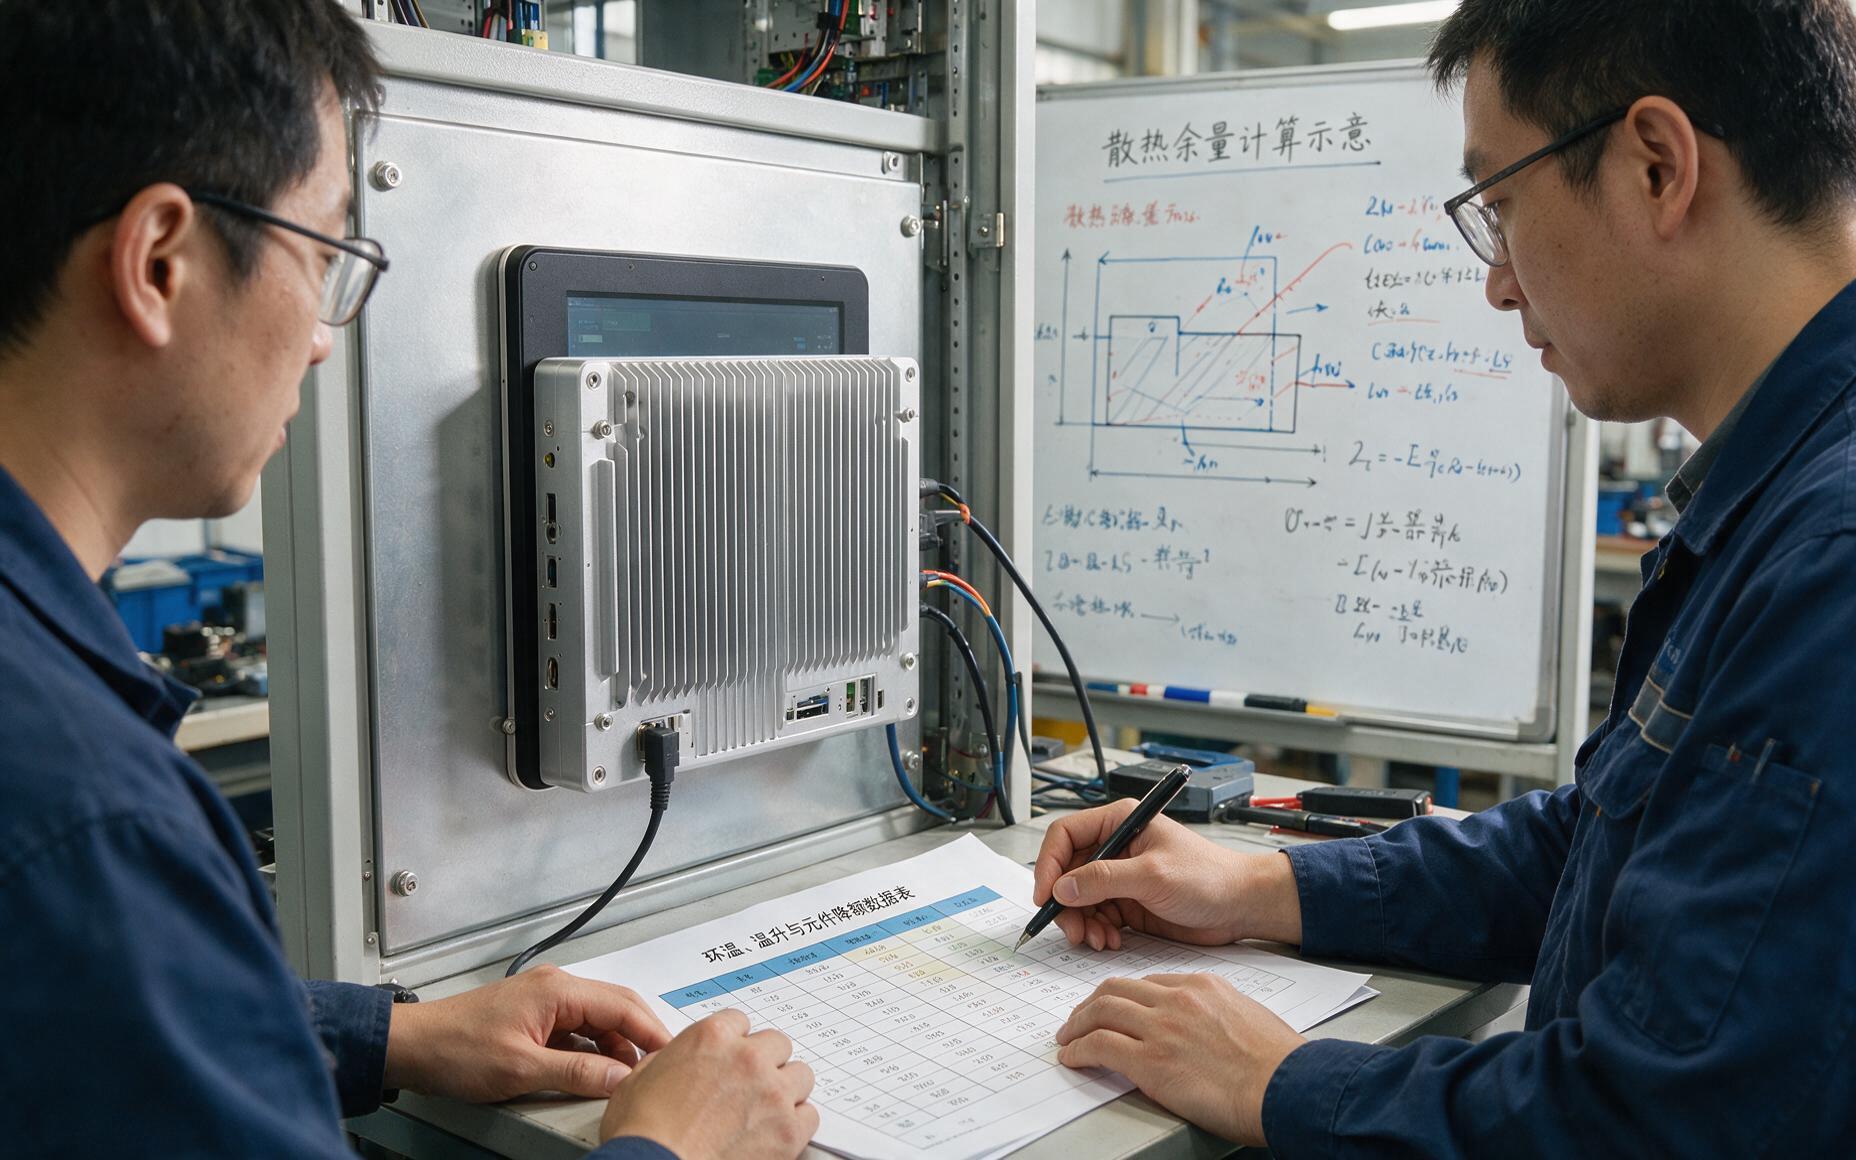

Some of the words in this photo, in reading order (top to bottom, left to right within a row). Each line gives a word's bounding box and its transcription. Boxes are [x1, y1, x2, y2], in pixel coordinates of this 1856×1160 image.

[1102, 112, 1371, 168] 散热余量计算示意
[701, 885, 916, 964] 环温、温升与元件降额数据表
